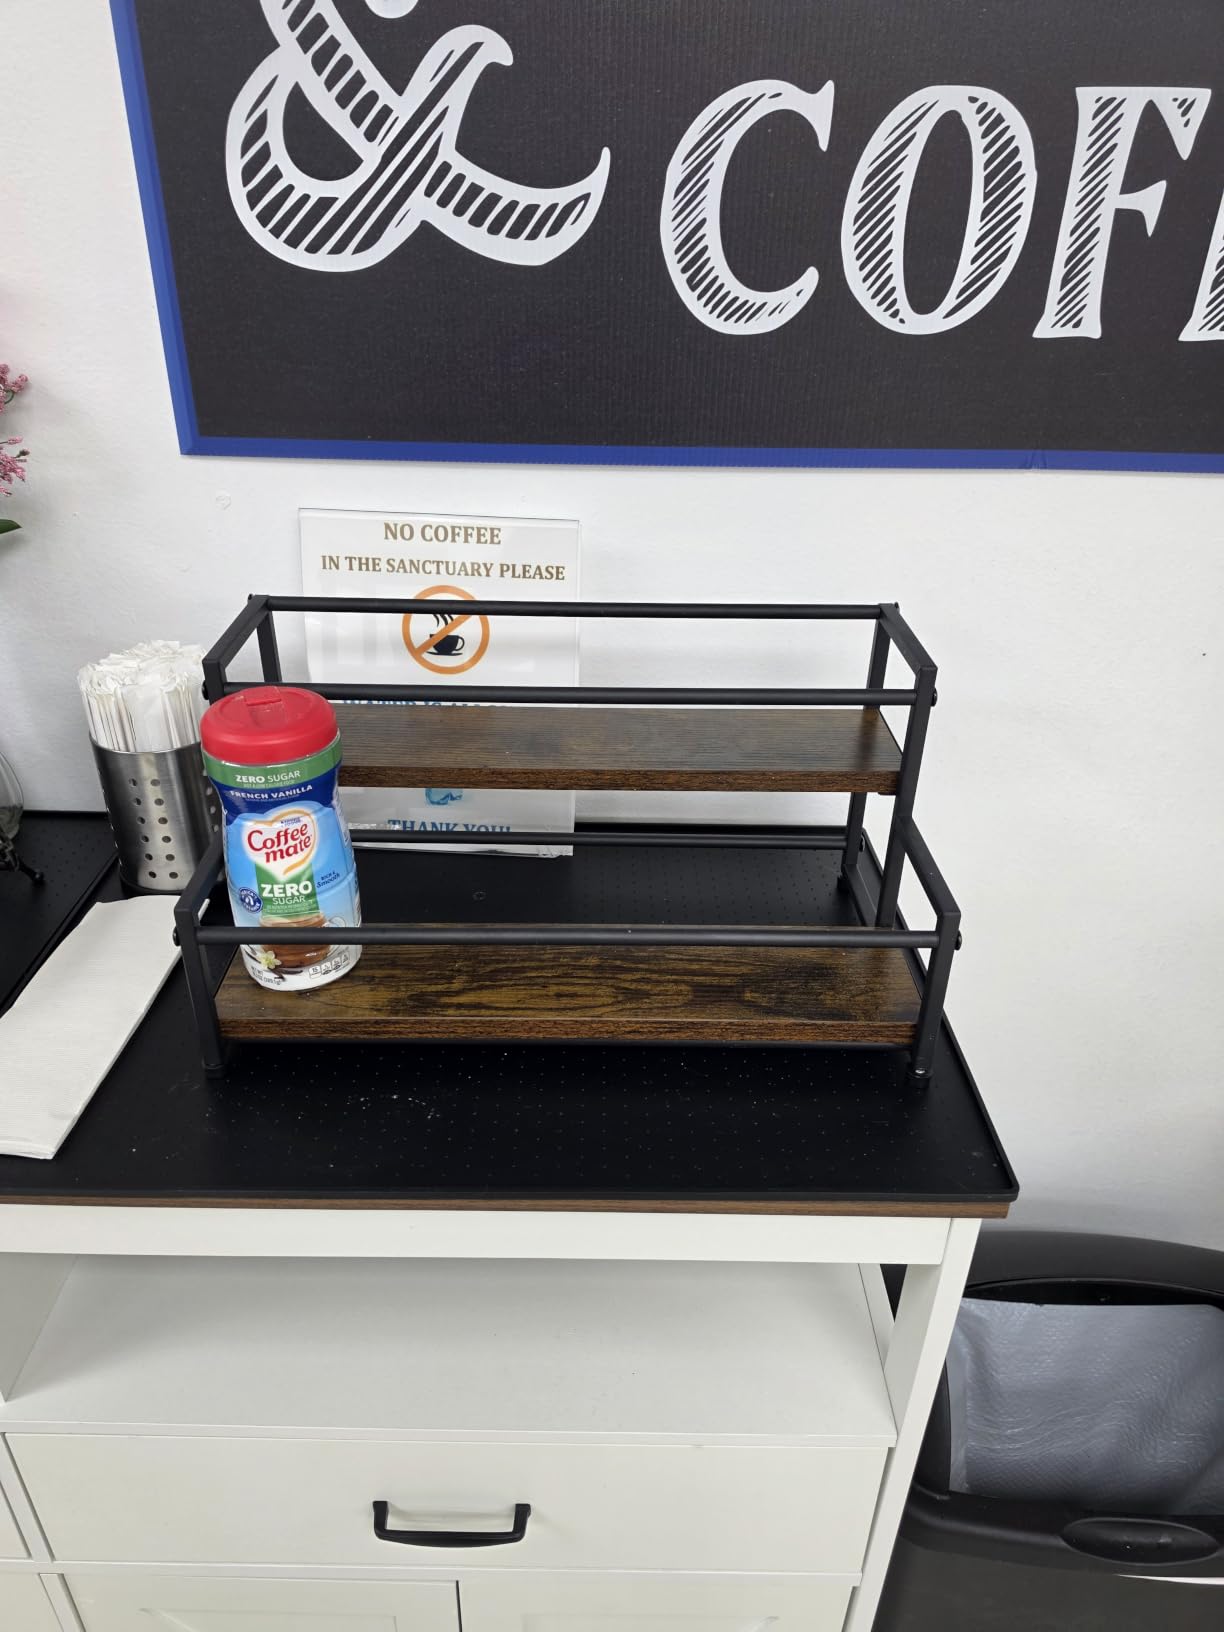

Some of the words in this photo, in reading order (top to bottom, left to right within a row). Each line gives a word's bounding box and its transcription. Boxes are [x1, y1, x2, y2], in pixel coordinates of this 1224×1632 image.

[225, 0, 611, 273] &
[660, 78, 1224, 341] COF
[383, 521, 415, 542] NO
[419, 523, 502, 546] COFFEE
[320, 554, 340, 571] IN
[344, 556, 382, 573] THE
[385, 558, 494, 578] SANCTUARY
[499, 563, 566, 581] PLEASE
[235, 774, 266, 784] ZERO
[267, 770, 301, 783] SUGAR
[229, 790, 269, 799] FRENCH
[270, 784, 313, 799] VANILLA
[387, 819, 458, 832] THANK
[247, 823, 309, 852] Coffee
[265, 835, 312, 864] mate
[260, 880, 313, 898] ZERO
[272, 895, 306, 905] SUGAR
